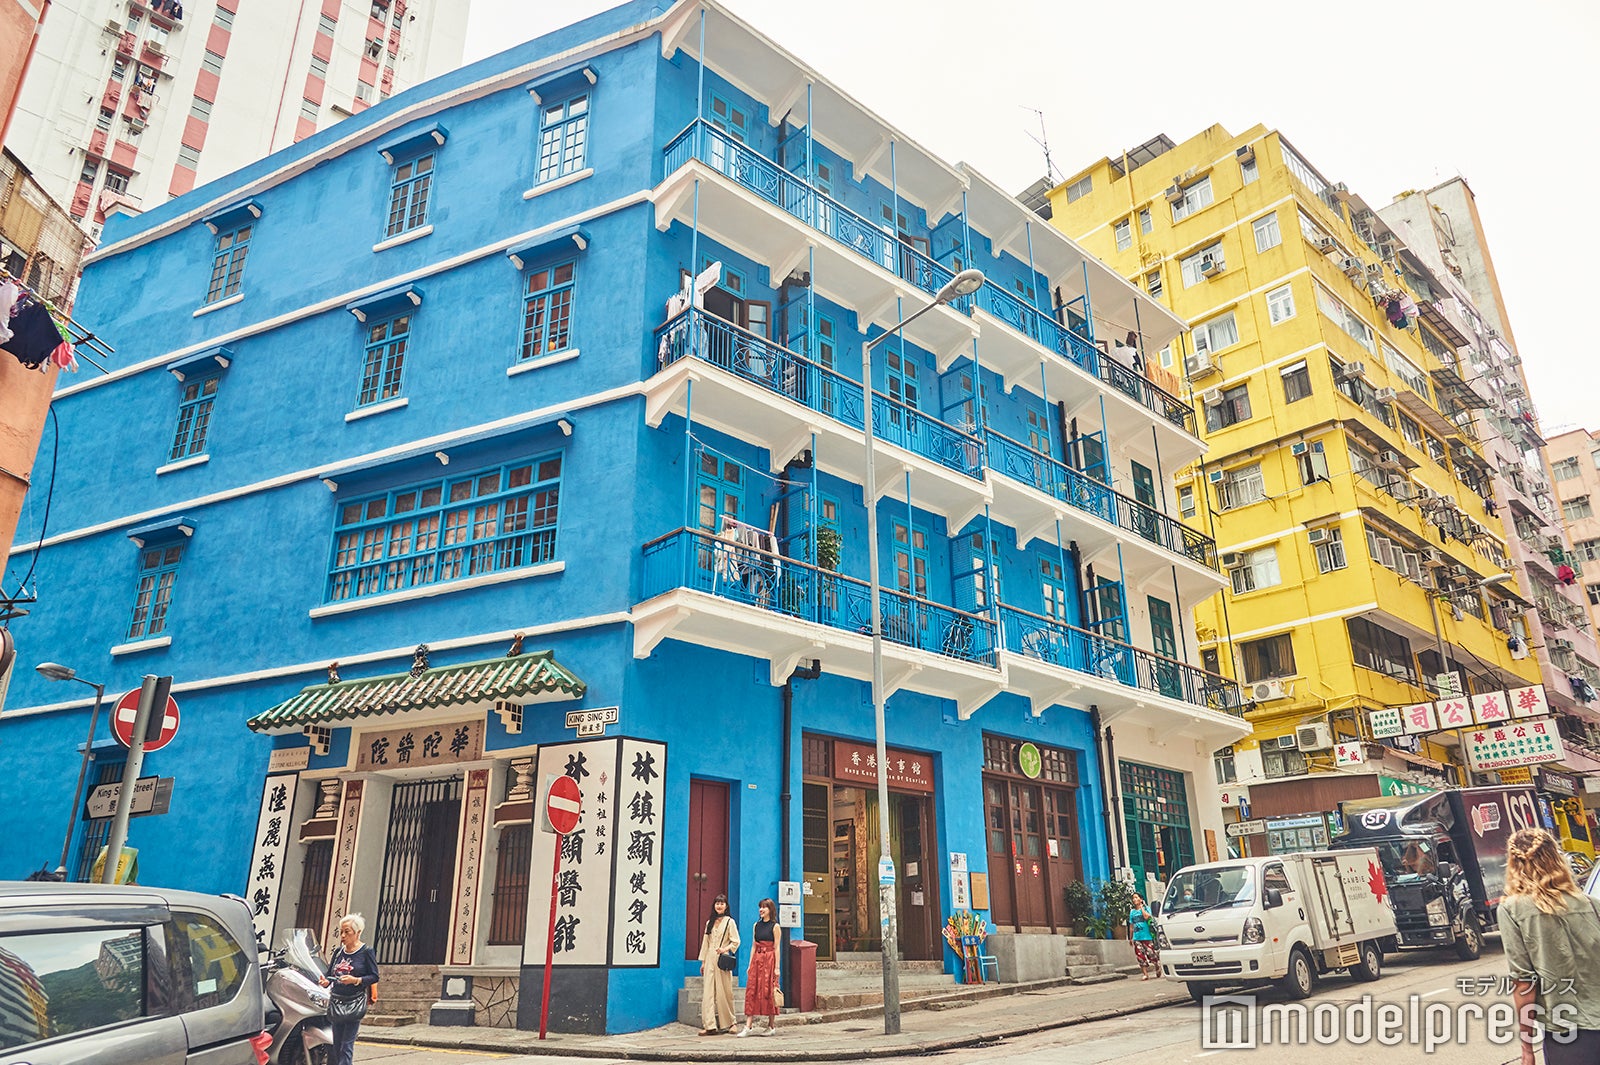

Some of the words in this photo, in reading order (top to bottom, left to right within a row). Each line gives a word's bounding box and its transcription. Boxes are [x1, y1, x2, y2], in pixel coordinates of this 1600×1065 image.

[568, 713, 585, 724] KING
[587, 711, 603, 722] SING
[605, 710, 615, 720] ST
[1473, 723, 1547, 744] 華盛公司
[844, 767, 859, 776] Hong
[861, 770, 876, 778] Kong
[905, 776, 928, 785] Stories
[97, 787, 113, 799] King
[1366, 812, 1385, 824] SF
[626, 751, 659, 954] 林鎮顯健身院
[1343, 875, 1365, 885] CAMBIE
[1191, 954, 1214, 963] CAMBIE
